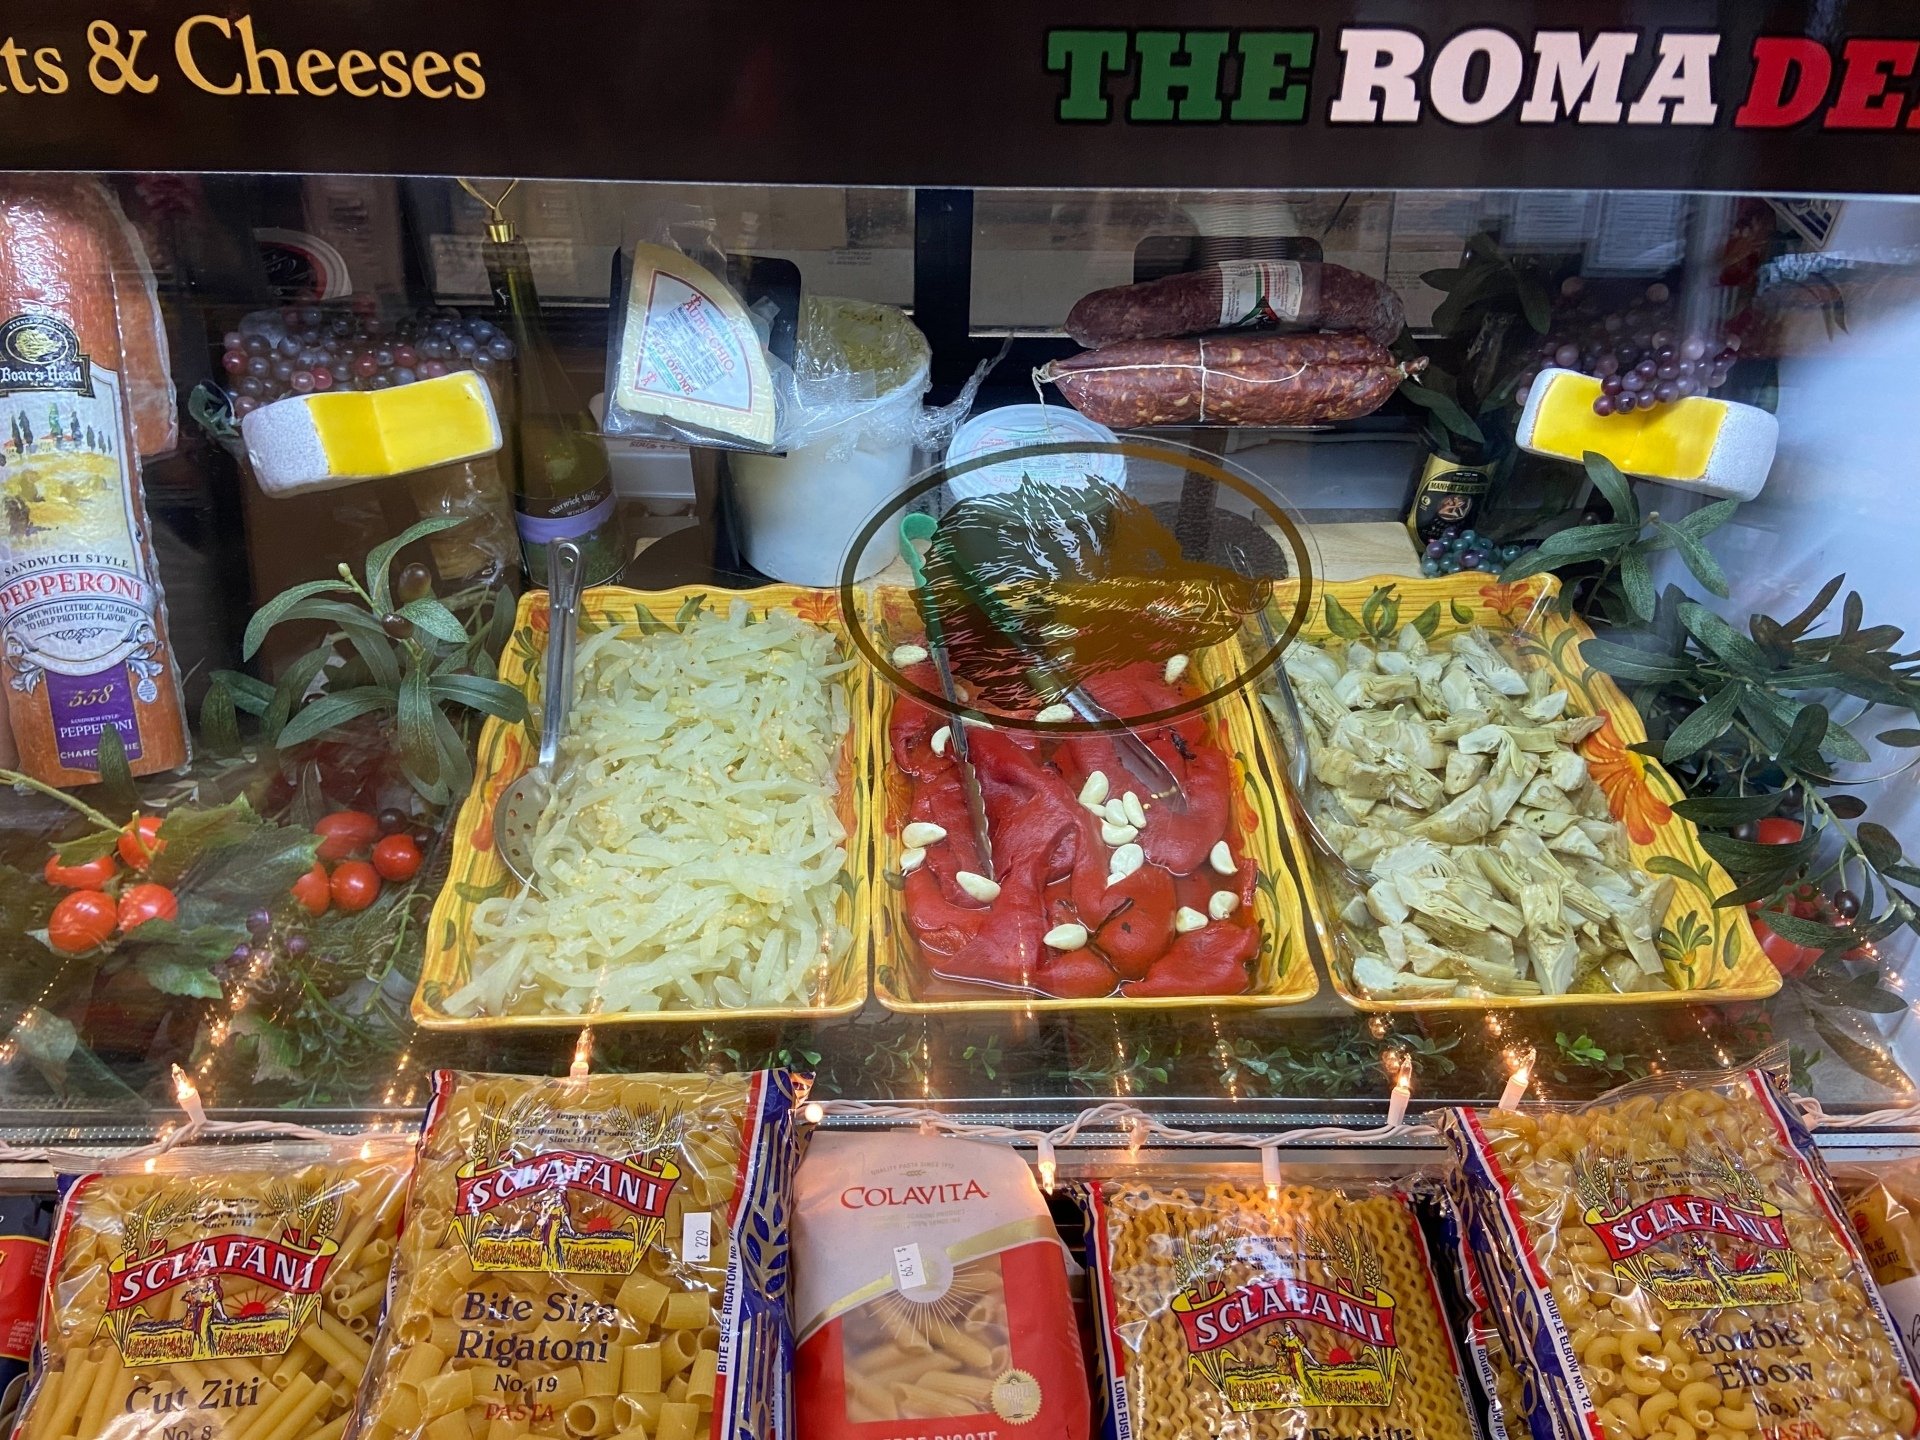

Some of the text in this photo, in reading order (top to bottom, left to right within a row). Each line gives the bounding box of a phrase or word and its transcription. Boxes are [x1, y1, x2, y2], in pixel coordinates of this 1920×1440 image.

[0, 14, 486, 99] ts & Cheeses
[1048, 29, 1920, 129] THE ROMA DE
[0, 365, 82, 382] Boar's Head
[648, 333, 694, 396] ROVOLONE
[548, 496, 580, 515] Warwick
[5, 554, 129, 576] SANDWICH STYLE
[0, 572, 142, 614] PEPPERONI
[25, 621, 36, 631] TO
[37, 617, 55, 628] HELP
[56, 613, 96, 623] PROTECT
[41, 605, 63, 616] WITH
[64, 602, 93, 612] CITRIC
[94, 602, 114, 612] ACID
[115, 605, 140, 618] ADDED
[69, 684, 114, 707] 558
[538, 1128, 569, 1136] Quality
[598, 1128, 638, 1137] Products
[548, 1136, 598, 1144] Since 1911
[1635, 1157, 1679, 1166] Importers
[1663, 1170, 1685, 1179] Food
[470, 1157, 657, 1211] SCLAFANI
[840, 1179, 990, 1210] COLAVITA
[1612, 1202, 1782, 1251] SCLAFANI
[119, 1241, 315, 1303] SCLAFANI
[723, 1262, 738, 1316] RIGATONI
[1864, 1279, 1874, 1294] NO.
[461, 1292, 617, 1323] Bite Size
[1195, 1286, 1385, 1344] SCLAFANI
[1871, 1295, 1891, 1332] ELBOW
[720, 1318, 732, 1345] SIZE
[454, 1330, 610, 1369] Rigatoni
[717, 1347, 730, 1373] BITE
[493, 1374, 558, 1393] No. 19
[1560, 1335, 1580, 1374] ELBOW
[1573, 1375, 1586, 1394] NO.
[1581, 1396, 1593, 1410] 12
[1713, 1359, 1816, 1391] Elbow
[125, 1376, 260, 1415] Cut Ziti
[1754, 1397, 1814, 1417] No. 12
[484, 1403, 556, 1423] PASTA
[1114, 1381, 1131, 1440] LONG FUSIL
[162, 1425, 213, 1440] No. 8
[1761, 1421, 1826, 1440] PASTA
